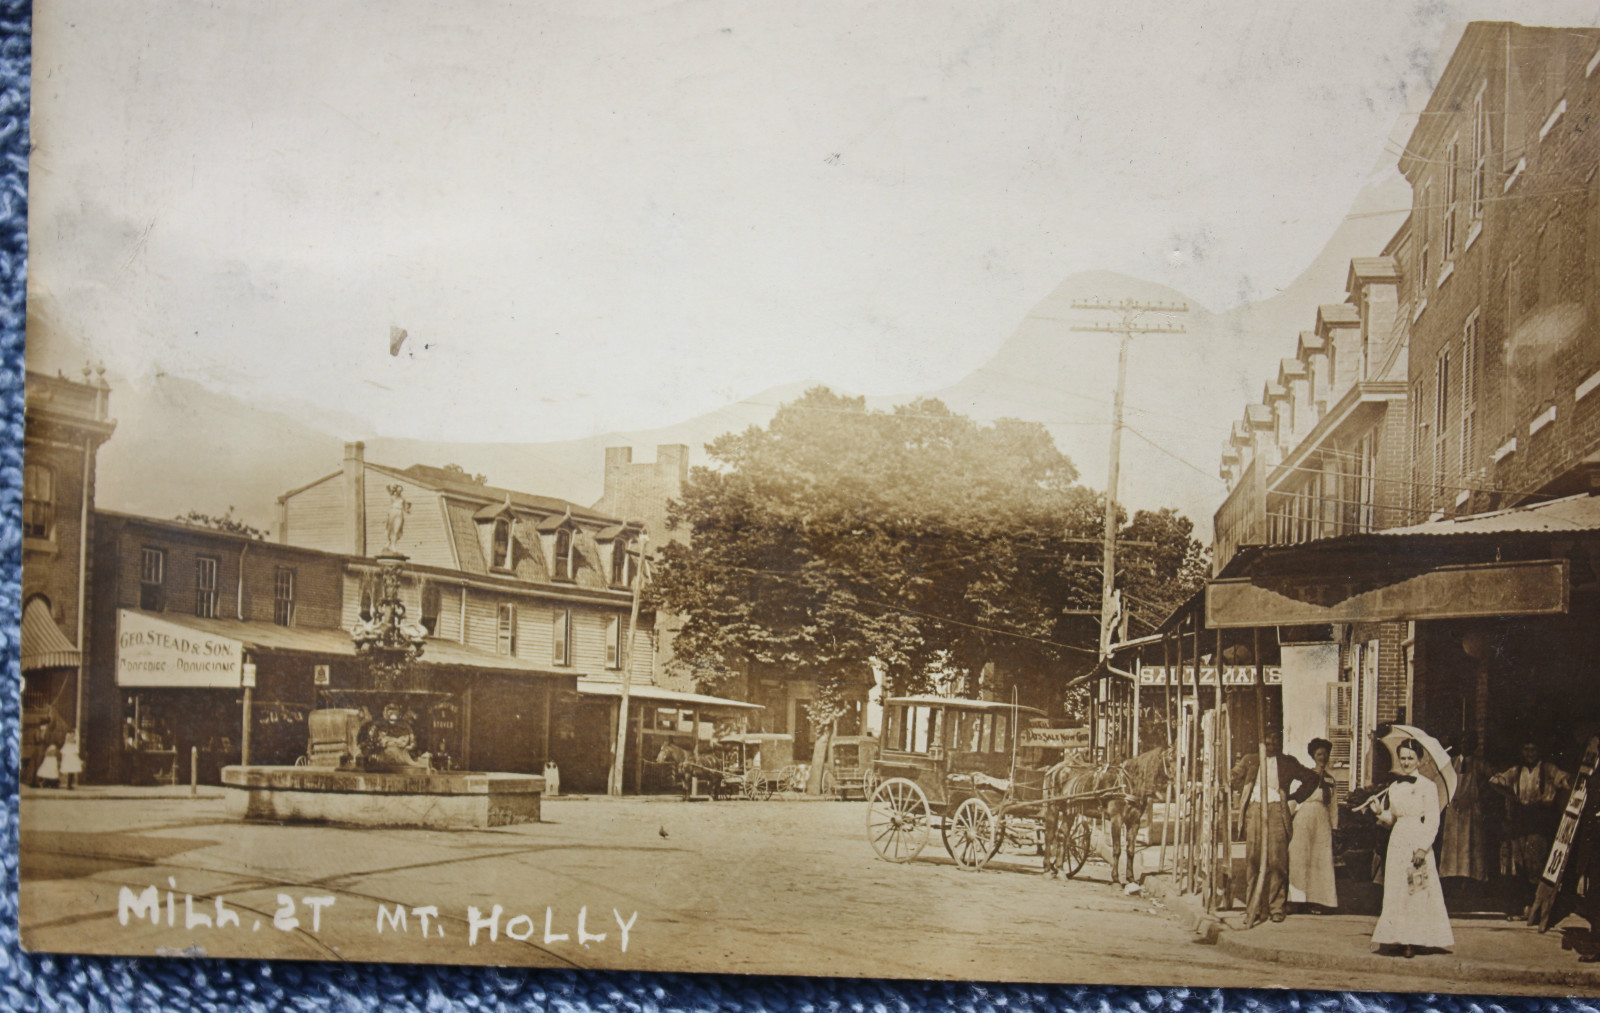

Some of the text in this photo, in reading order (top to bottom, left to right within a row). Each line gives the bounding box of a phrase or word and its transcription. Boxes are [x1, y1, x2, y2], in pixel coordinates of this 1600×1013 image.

[147, 630, 190, 654] STEAD
[191, 643, 201, 655] &
[467, 904, 638, 953] HOLLY
